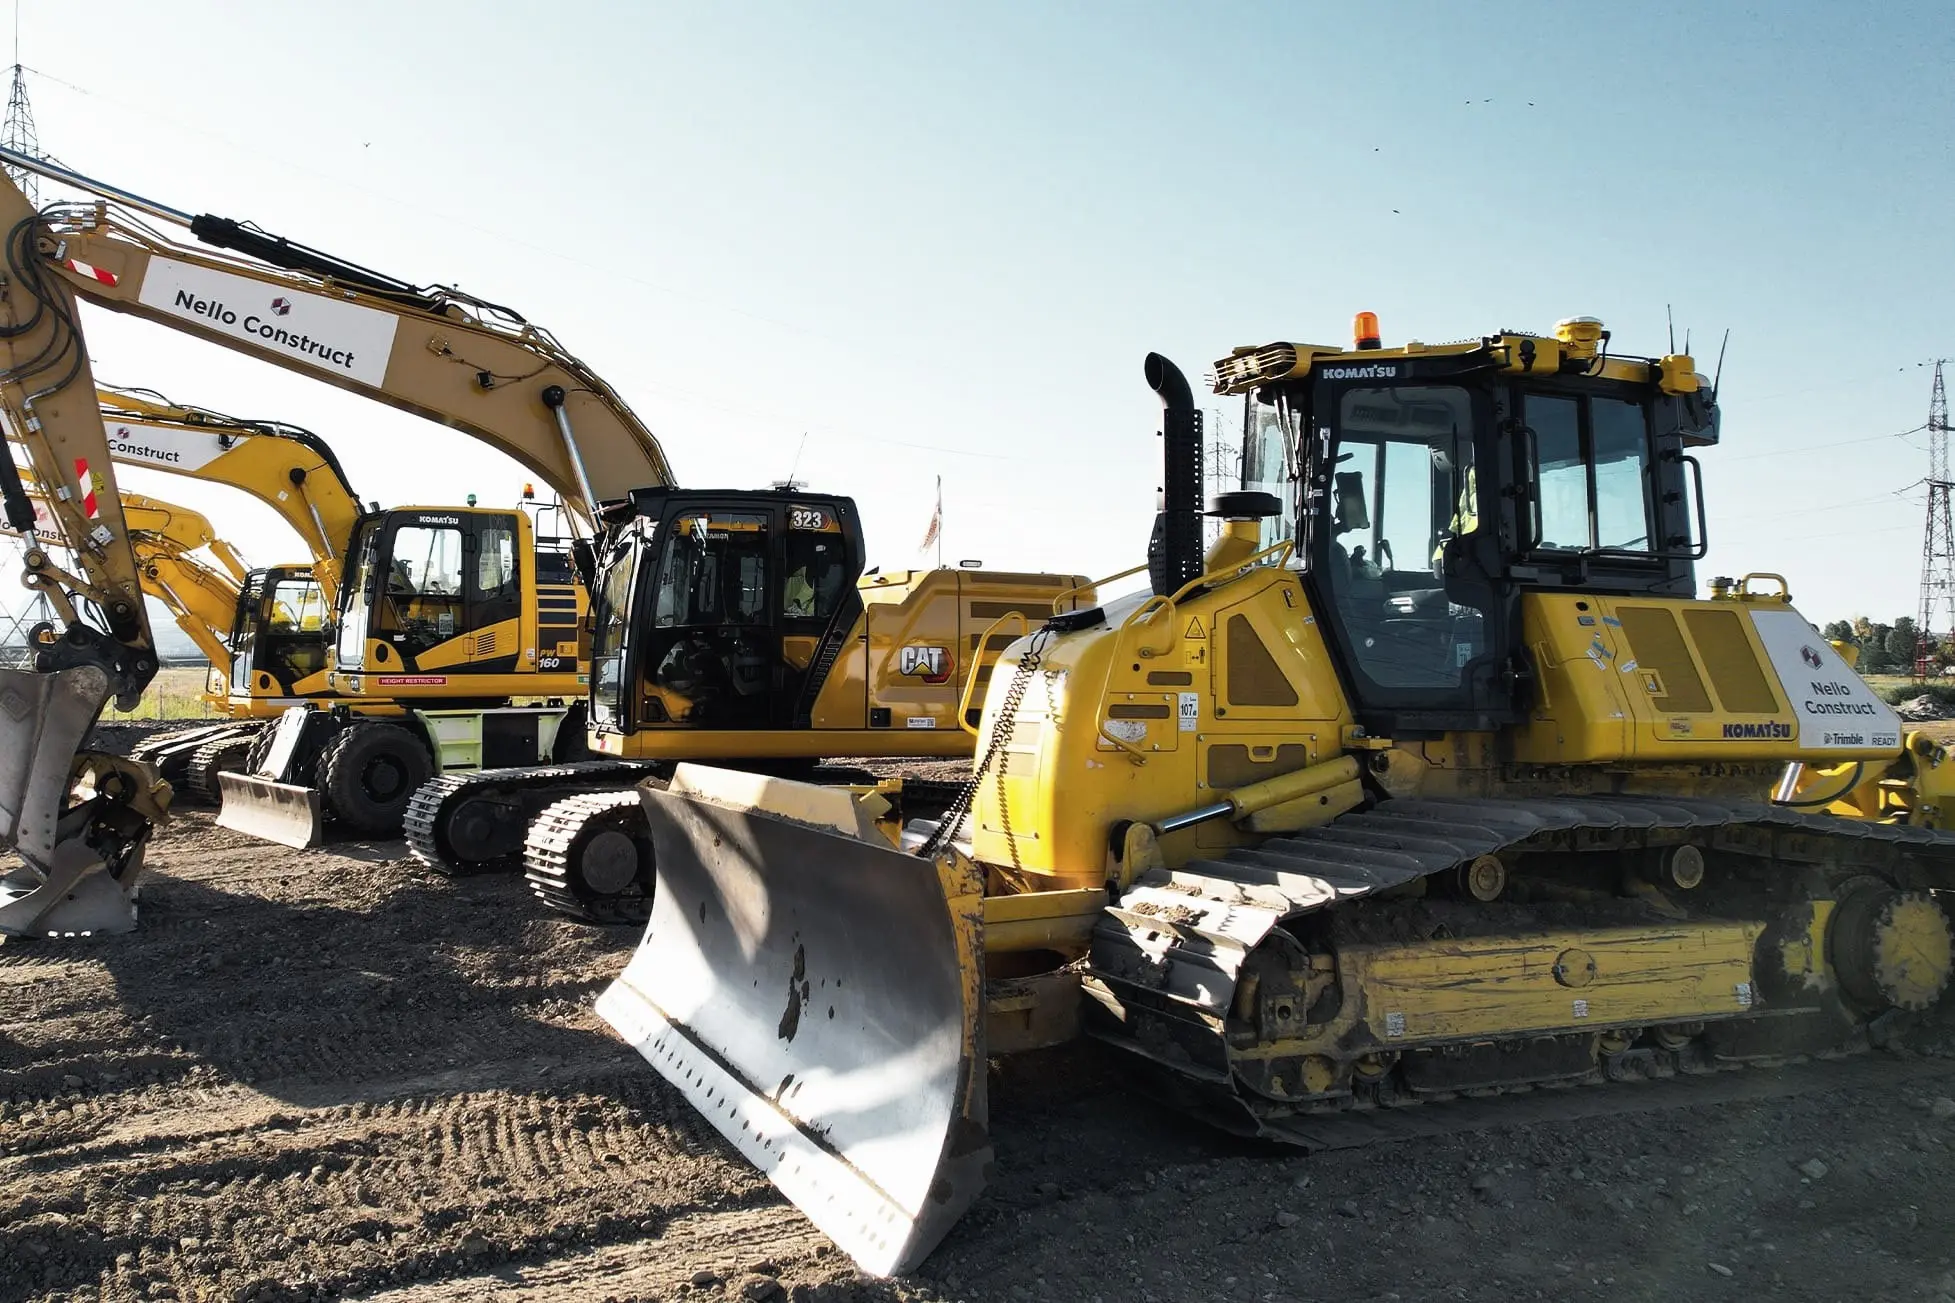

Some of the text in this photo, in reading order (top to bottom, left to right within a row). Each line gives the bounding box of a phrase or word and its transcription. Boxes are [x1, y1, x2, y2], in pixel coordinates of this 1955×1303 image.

[175, 290, 355, 369] Nello Construct
[1323, 364, 1396, 379] KOMATSU
[108, 439, 180, 462] Construct
[419, 516, 459, 524] KOMATSU
[793, 511, 822, 528] 323
[539, 658, 560, 668] 160
[901, 646, 943, 675] CAT
[1811, 682, 1851, 696] Nello
[1181, 703, 1193, 716] 107
[1804, 700, 1877, 715] Construct
[1723, 720, 1791, 738] KOMATSU
[1833, 733, 1863, 745] Trimble
[1872, 738, 1897, 746] READY
